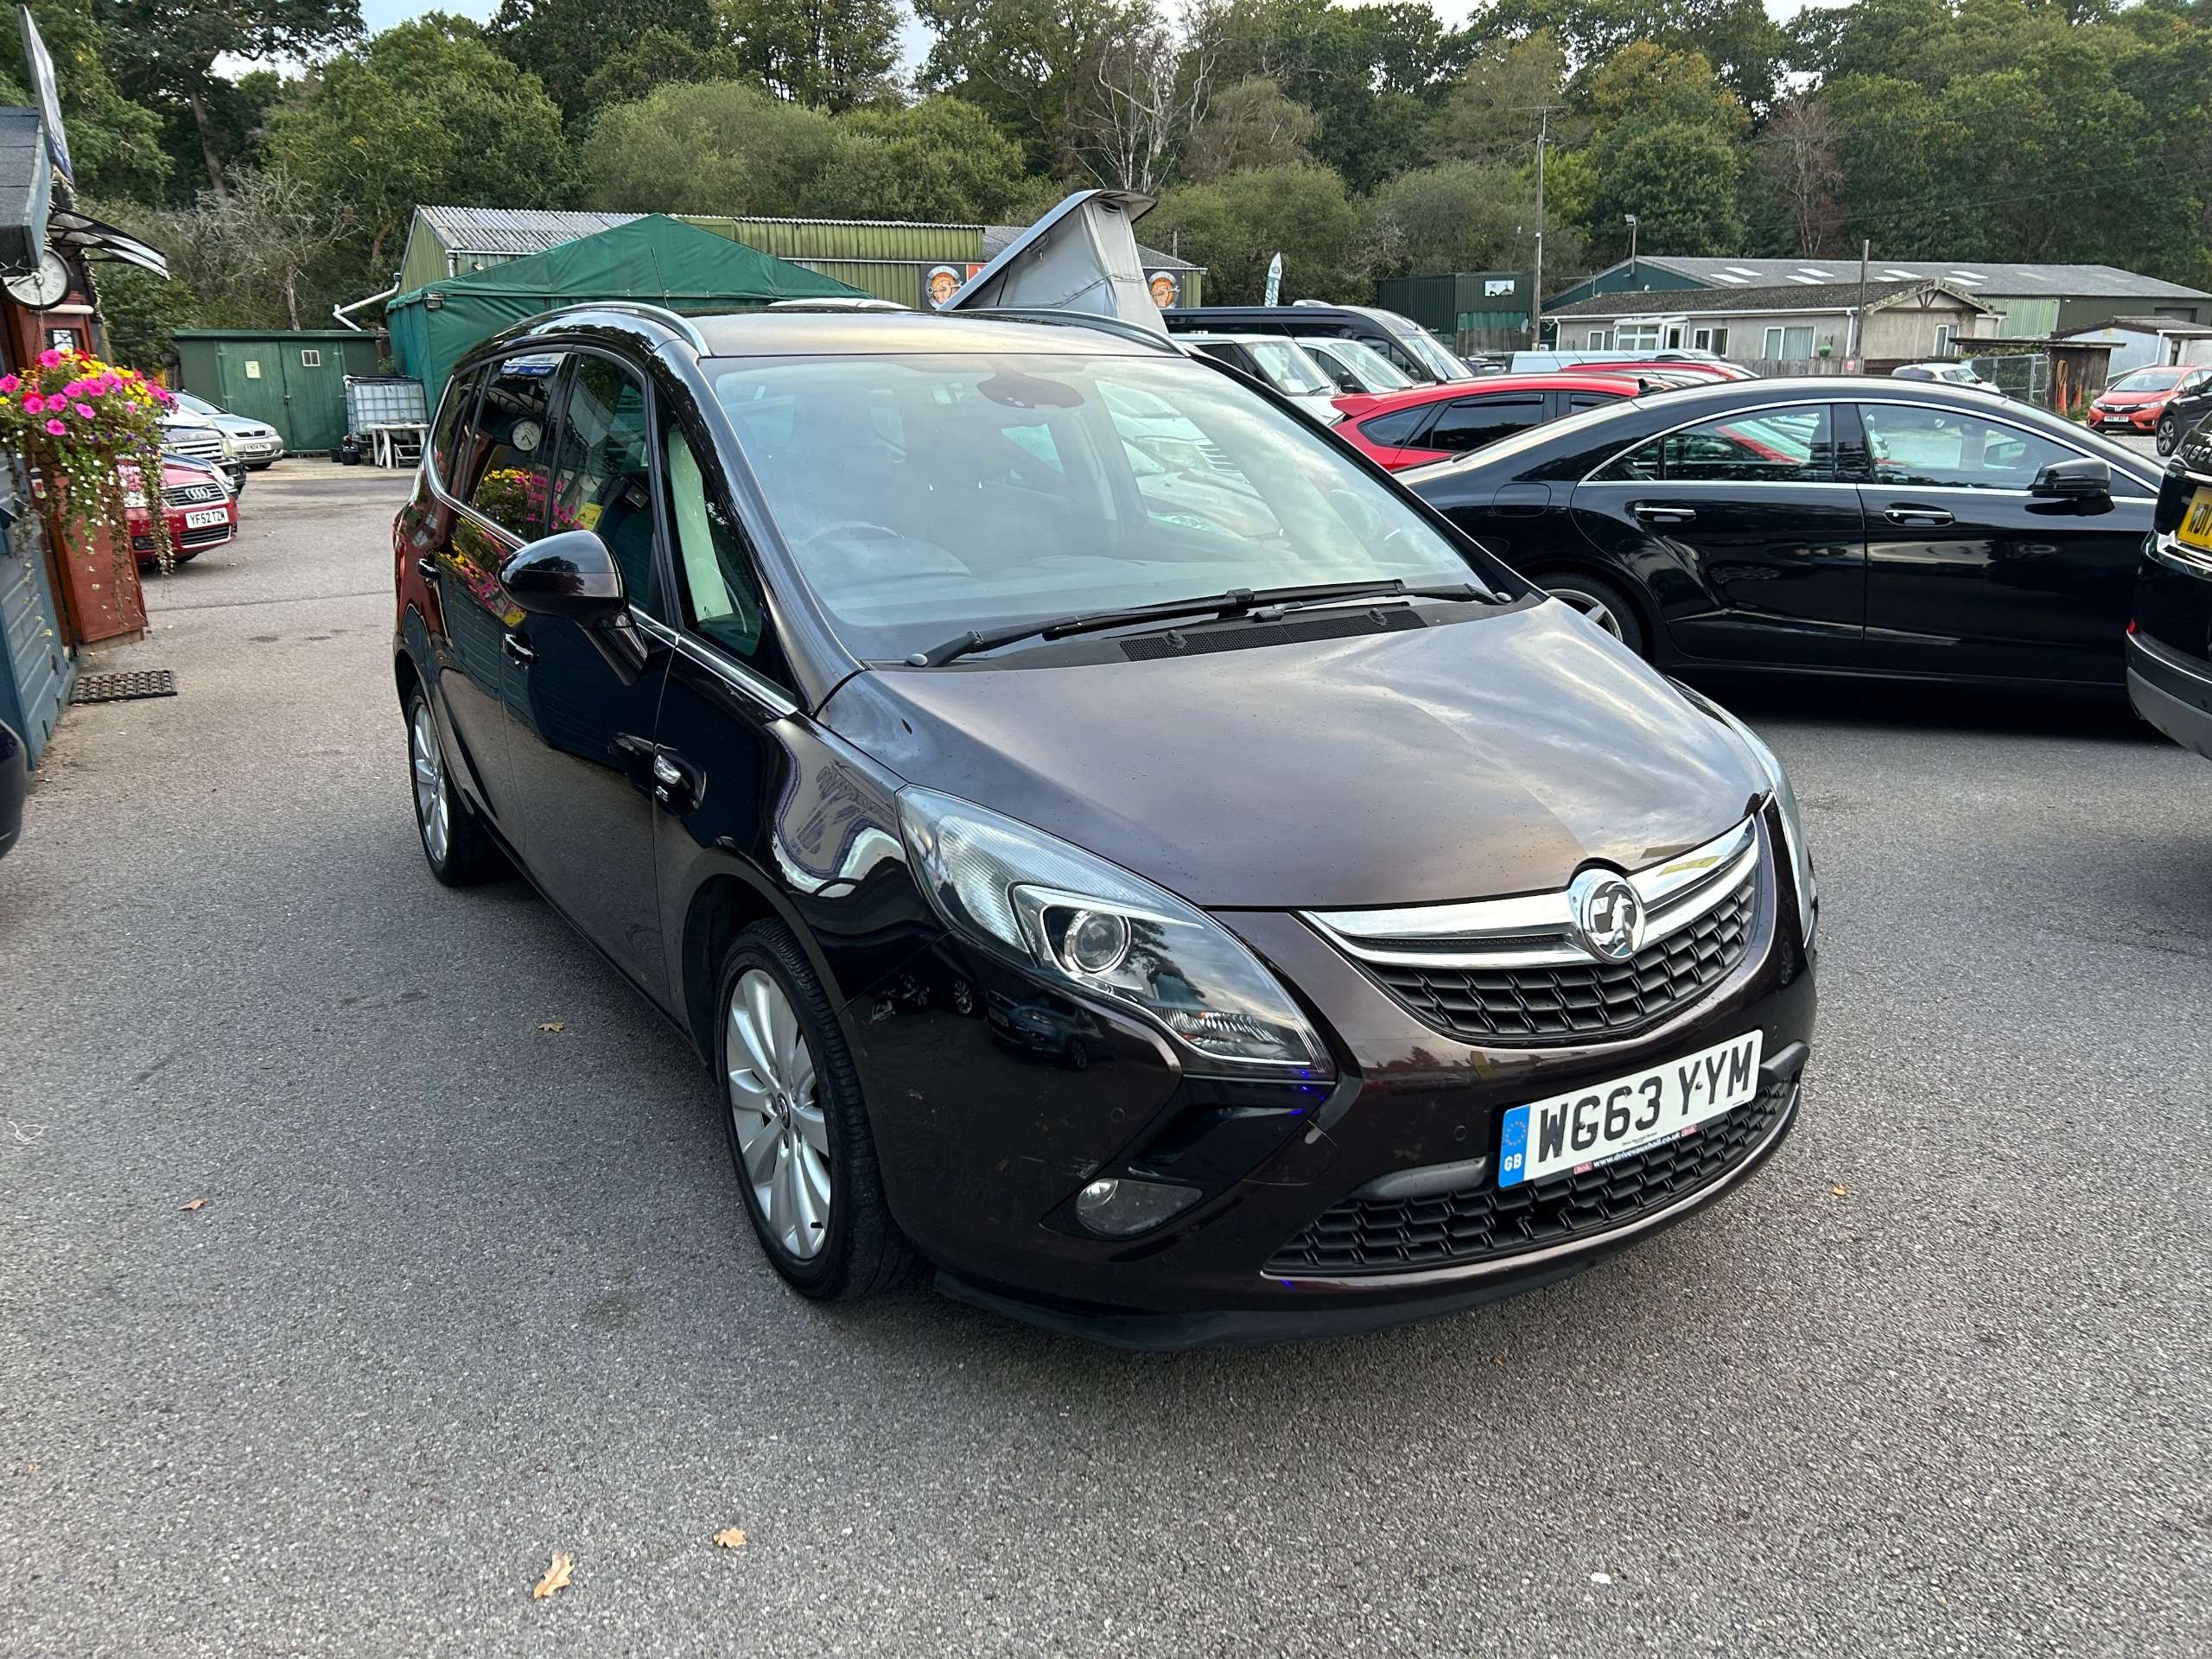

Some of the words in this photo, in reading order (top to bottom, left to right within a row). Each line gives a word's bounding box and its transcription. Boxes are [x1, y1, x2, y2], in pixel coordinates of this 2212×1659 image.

[1537, 1076, 1663, 1163] WG63
[1678, 1040, 1754, 1116] YYM
[1503, 1153, 1522, 1172] GB
